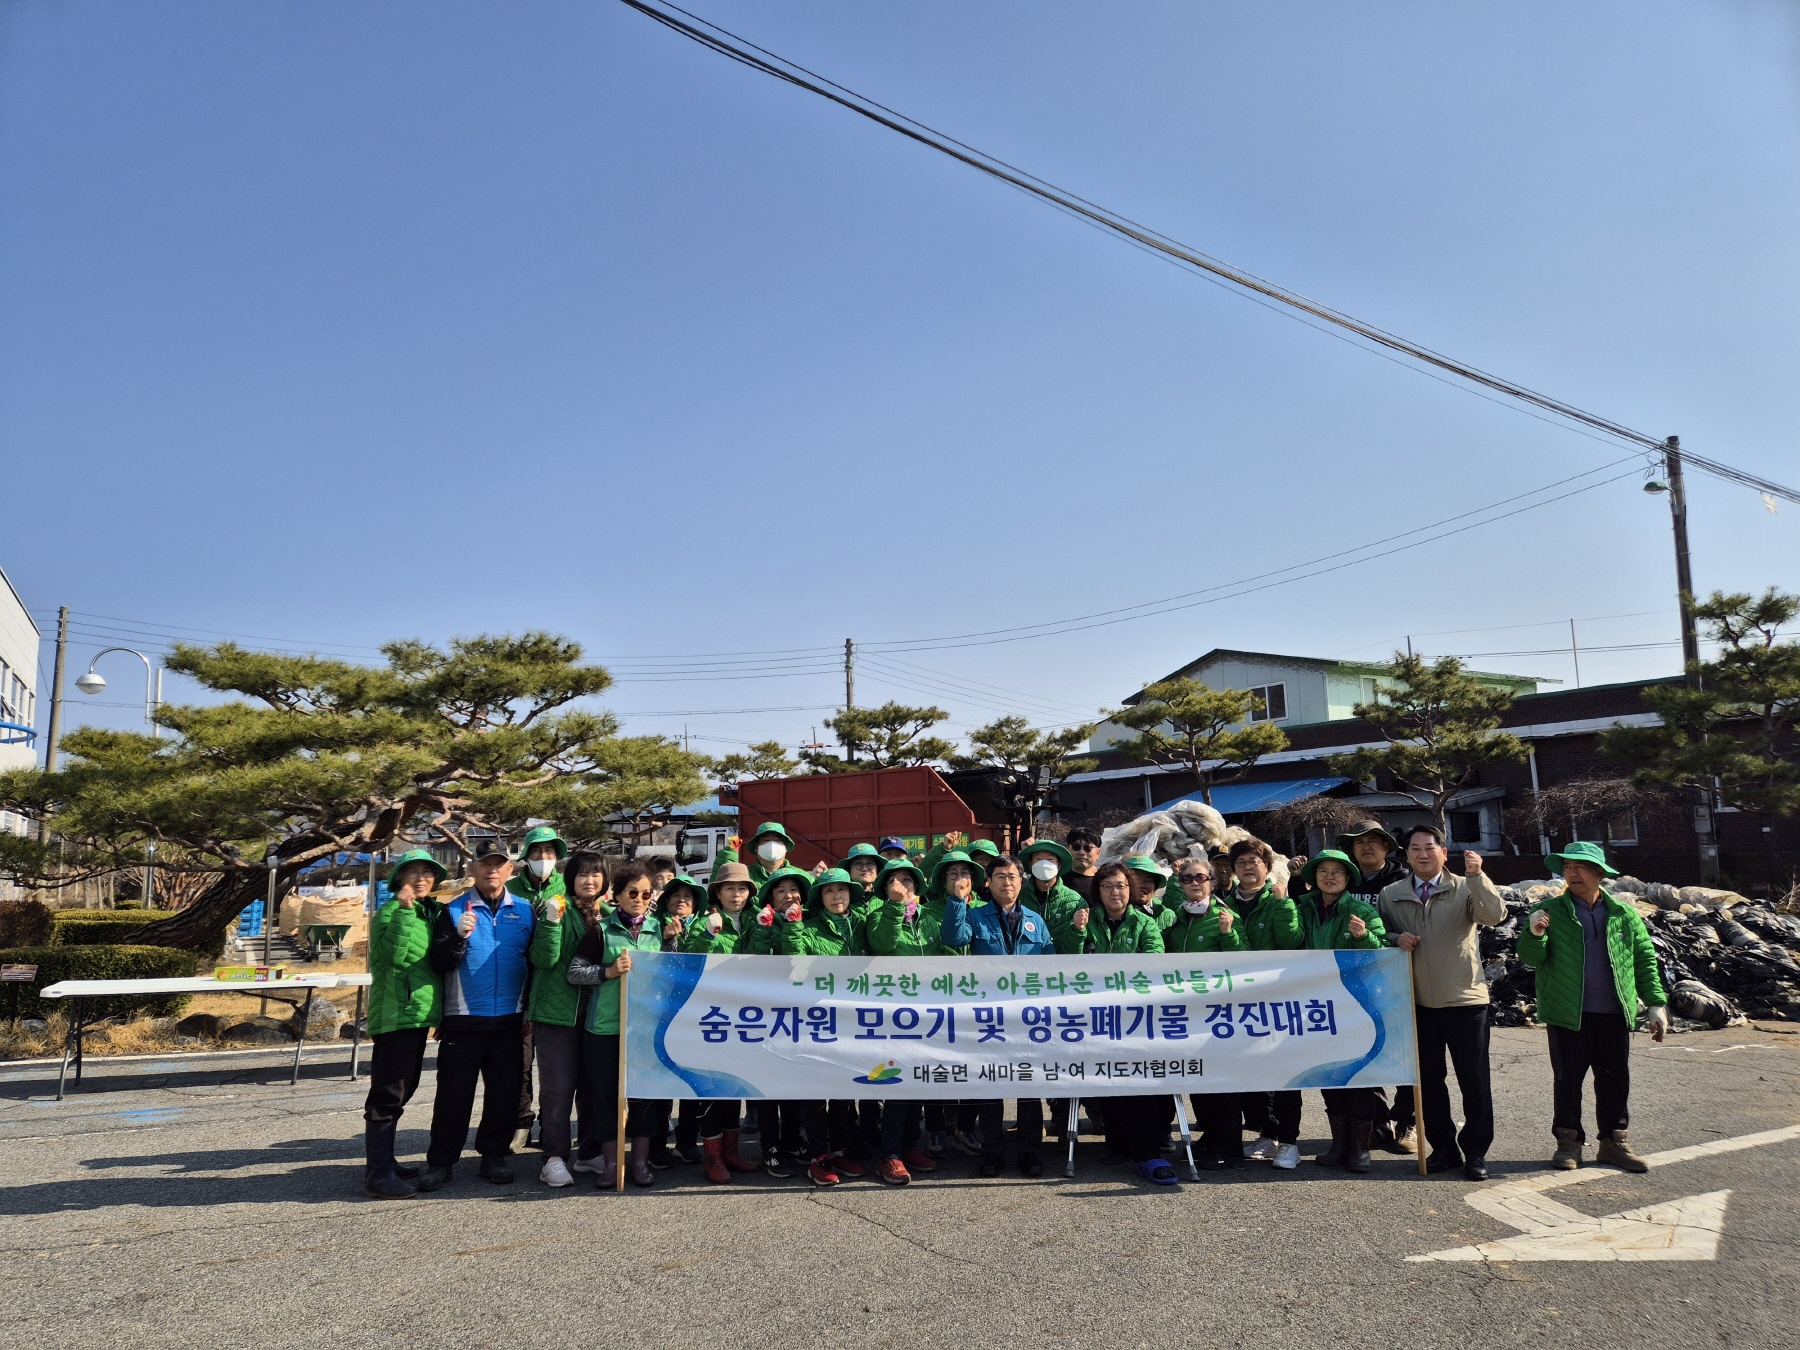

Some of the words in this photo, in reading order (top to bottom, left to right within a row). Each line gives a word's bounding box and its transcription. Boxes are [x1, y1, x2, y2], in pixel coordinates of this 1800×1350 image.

[814, 972, 835, 995] 더
[846, 972, 921, 997] 깨끗한
[930, 972, 987, 998] 예산,
[996, 970, 1094, 997] 아름다운
[1104, 970, 1152, 995] 대술
[1162, 969, 1233, 994] 만들기
[698, 1005, 838, 1043] 숨은자원
[854, 1007, 956, 1044] 모으기
[973, 1006, 1006, 1043] 및
[1021, 1004, 1189, 1043] 영농폐기물
[1204, 999, 1337, 1039] 경진대회
[913, 1063, 968, 1084] 대술면
[978, 1062, 1034, 1083] 새마을
[1043, 1061, 1085, 1081] 남·여
[1094, 1058, 1204, 1080] 지도자협의회
